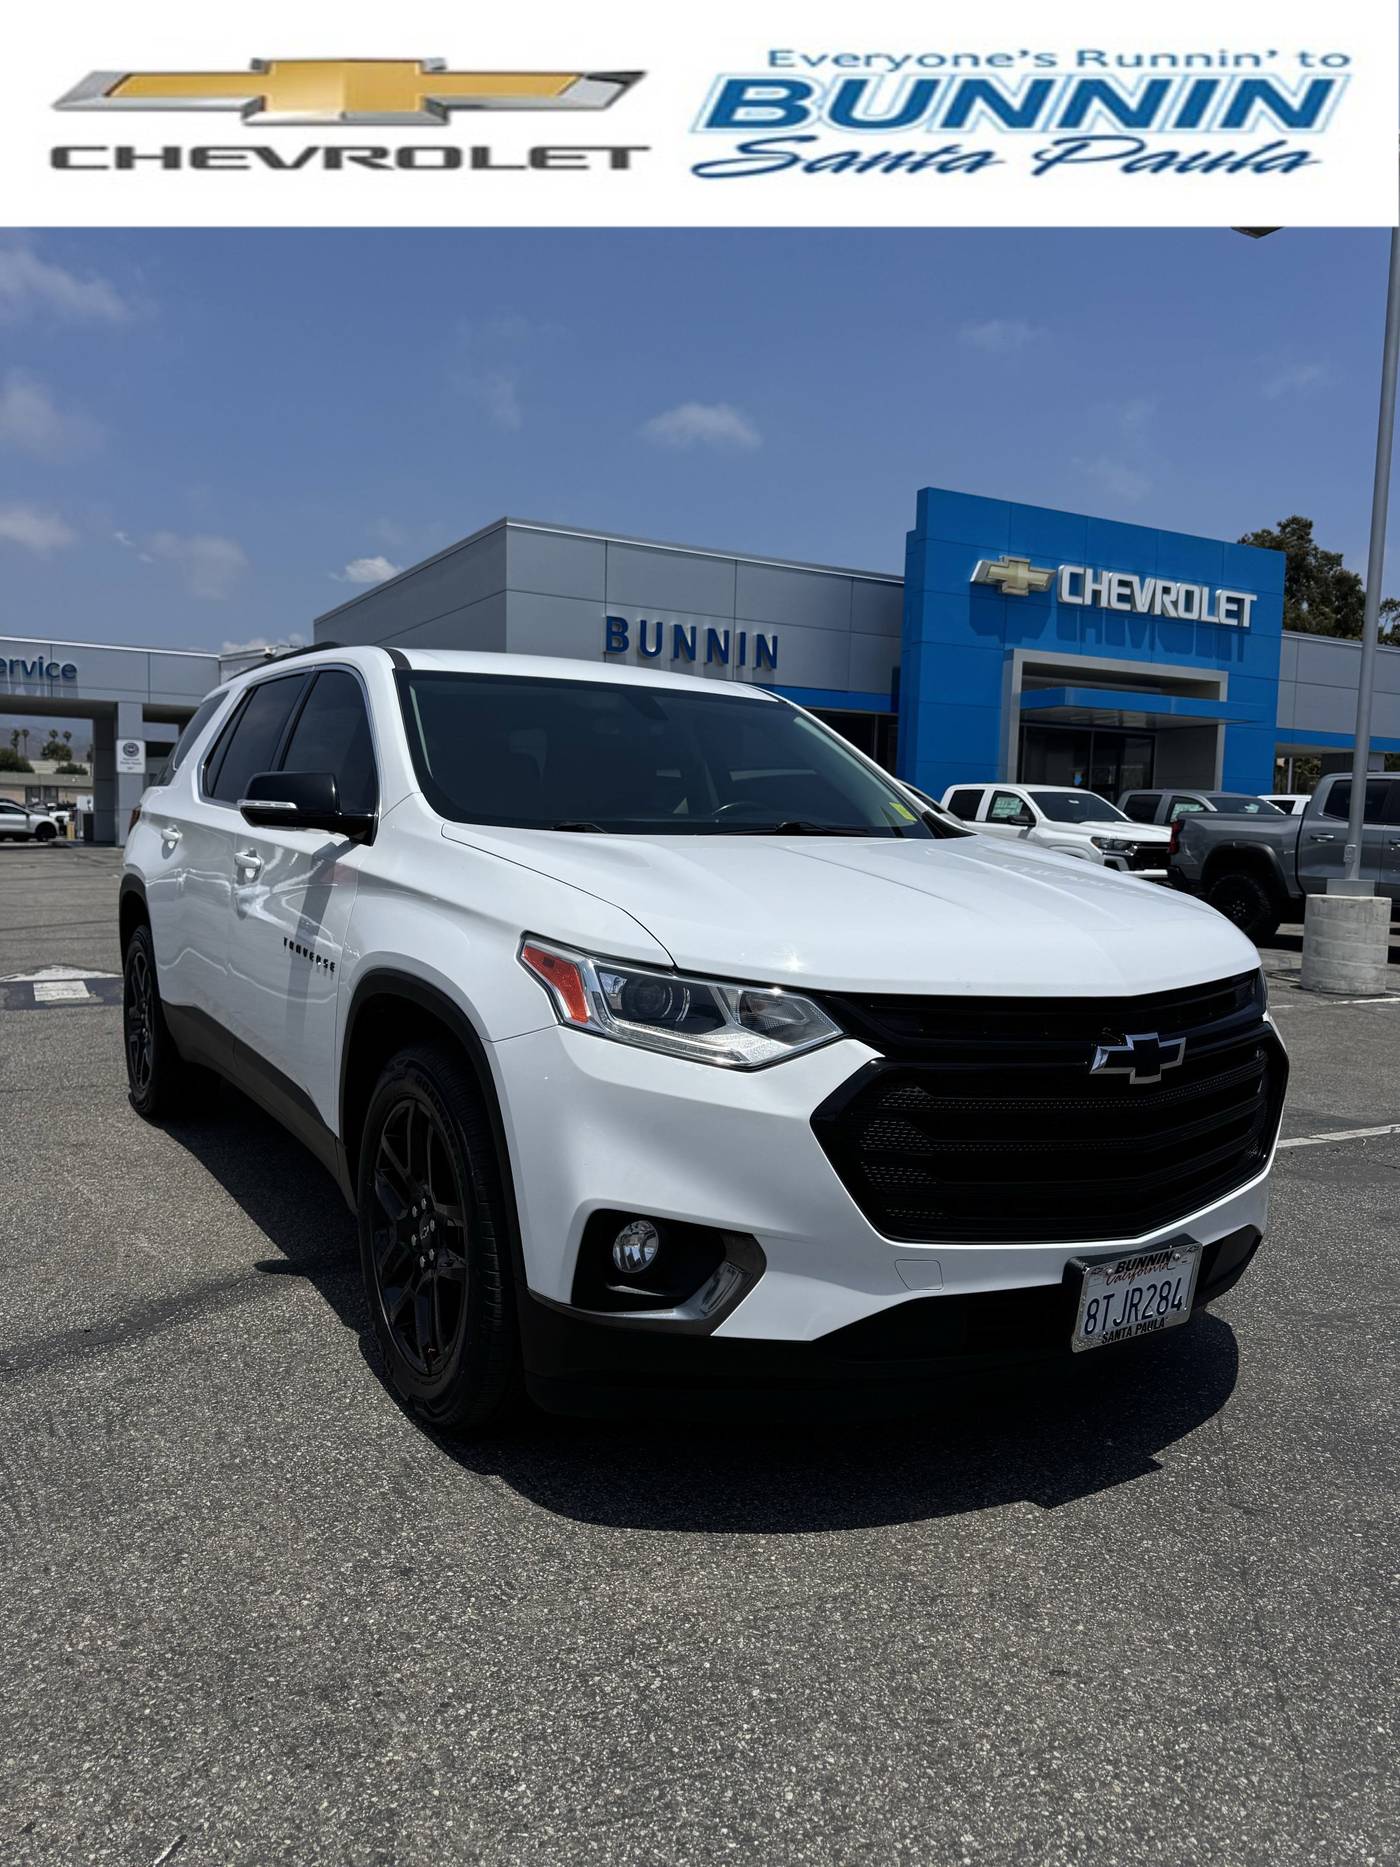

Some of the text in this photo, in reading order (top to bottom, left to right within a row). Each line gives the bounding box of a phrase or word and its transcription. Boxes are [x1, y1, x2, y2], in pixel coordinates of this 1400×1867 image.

[1057, 563, 1257, 628] CHEVROLET
[606, 615, 778, 670] BUNNIN
[283, 936, 336, 973] TRAVERSE
[1114, 1249, 1175, 1275] BUNNIN
[1084, 1277, 1183, 1336] 8TJR284
[1101, 1315, 1165, 1345] SANTA PAULA
